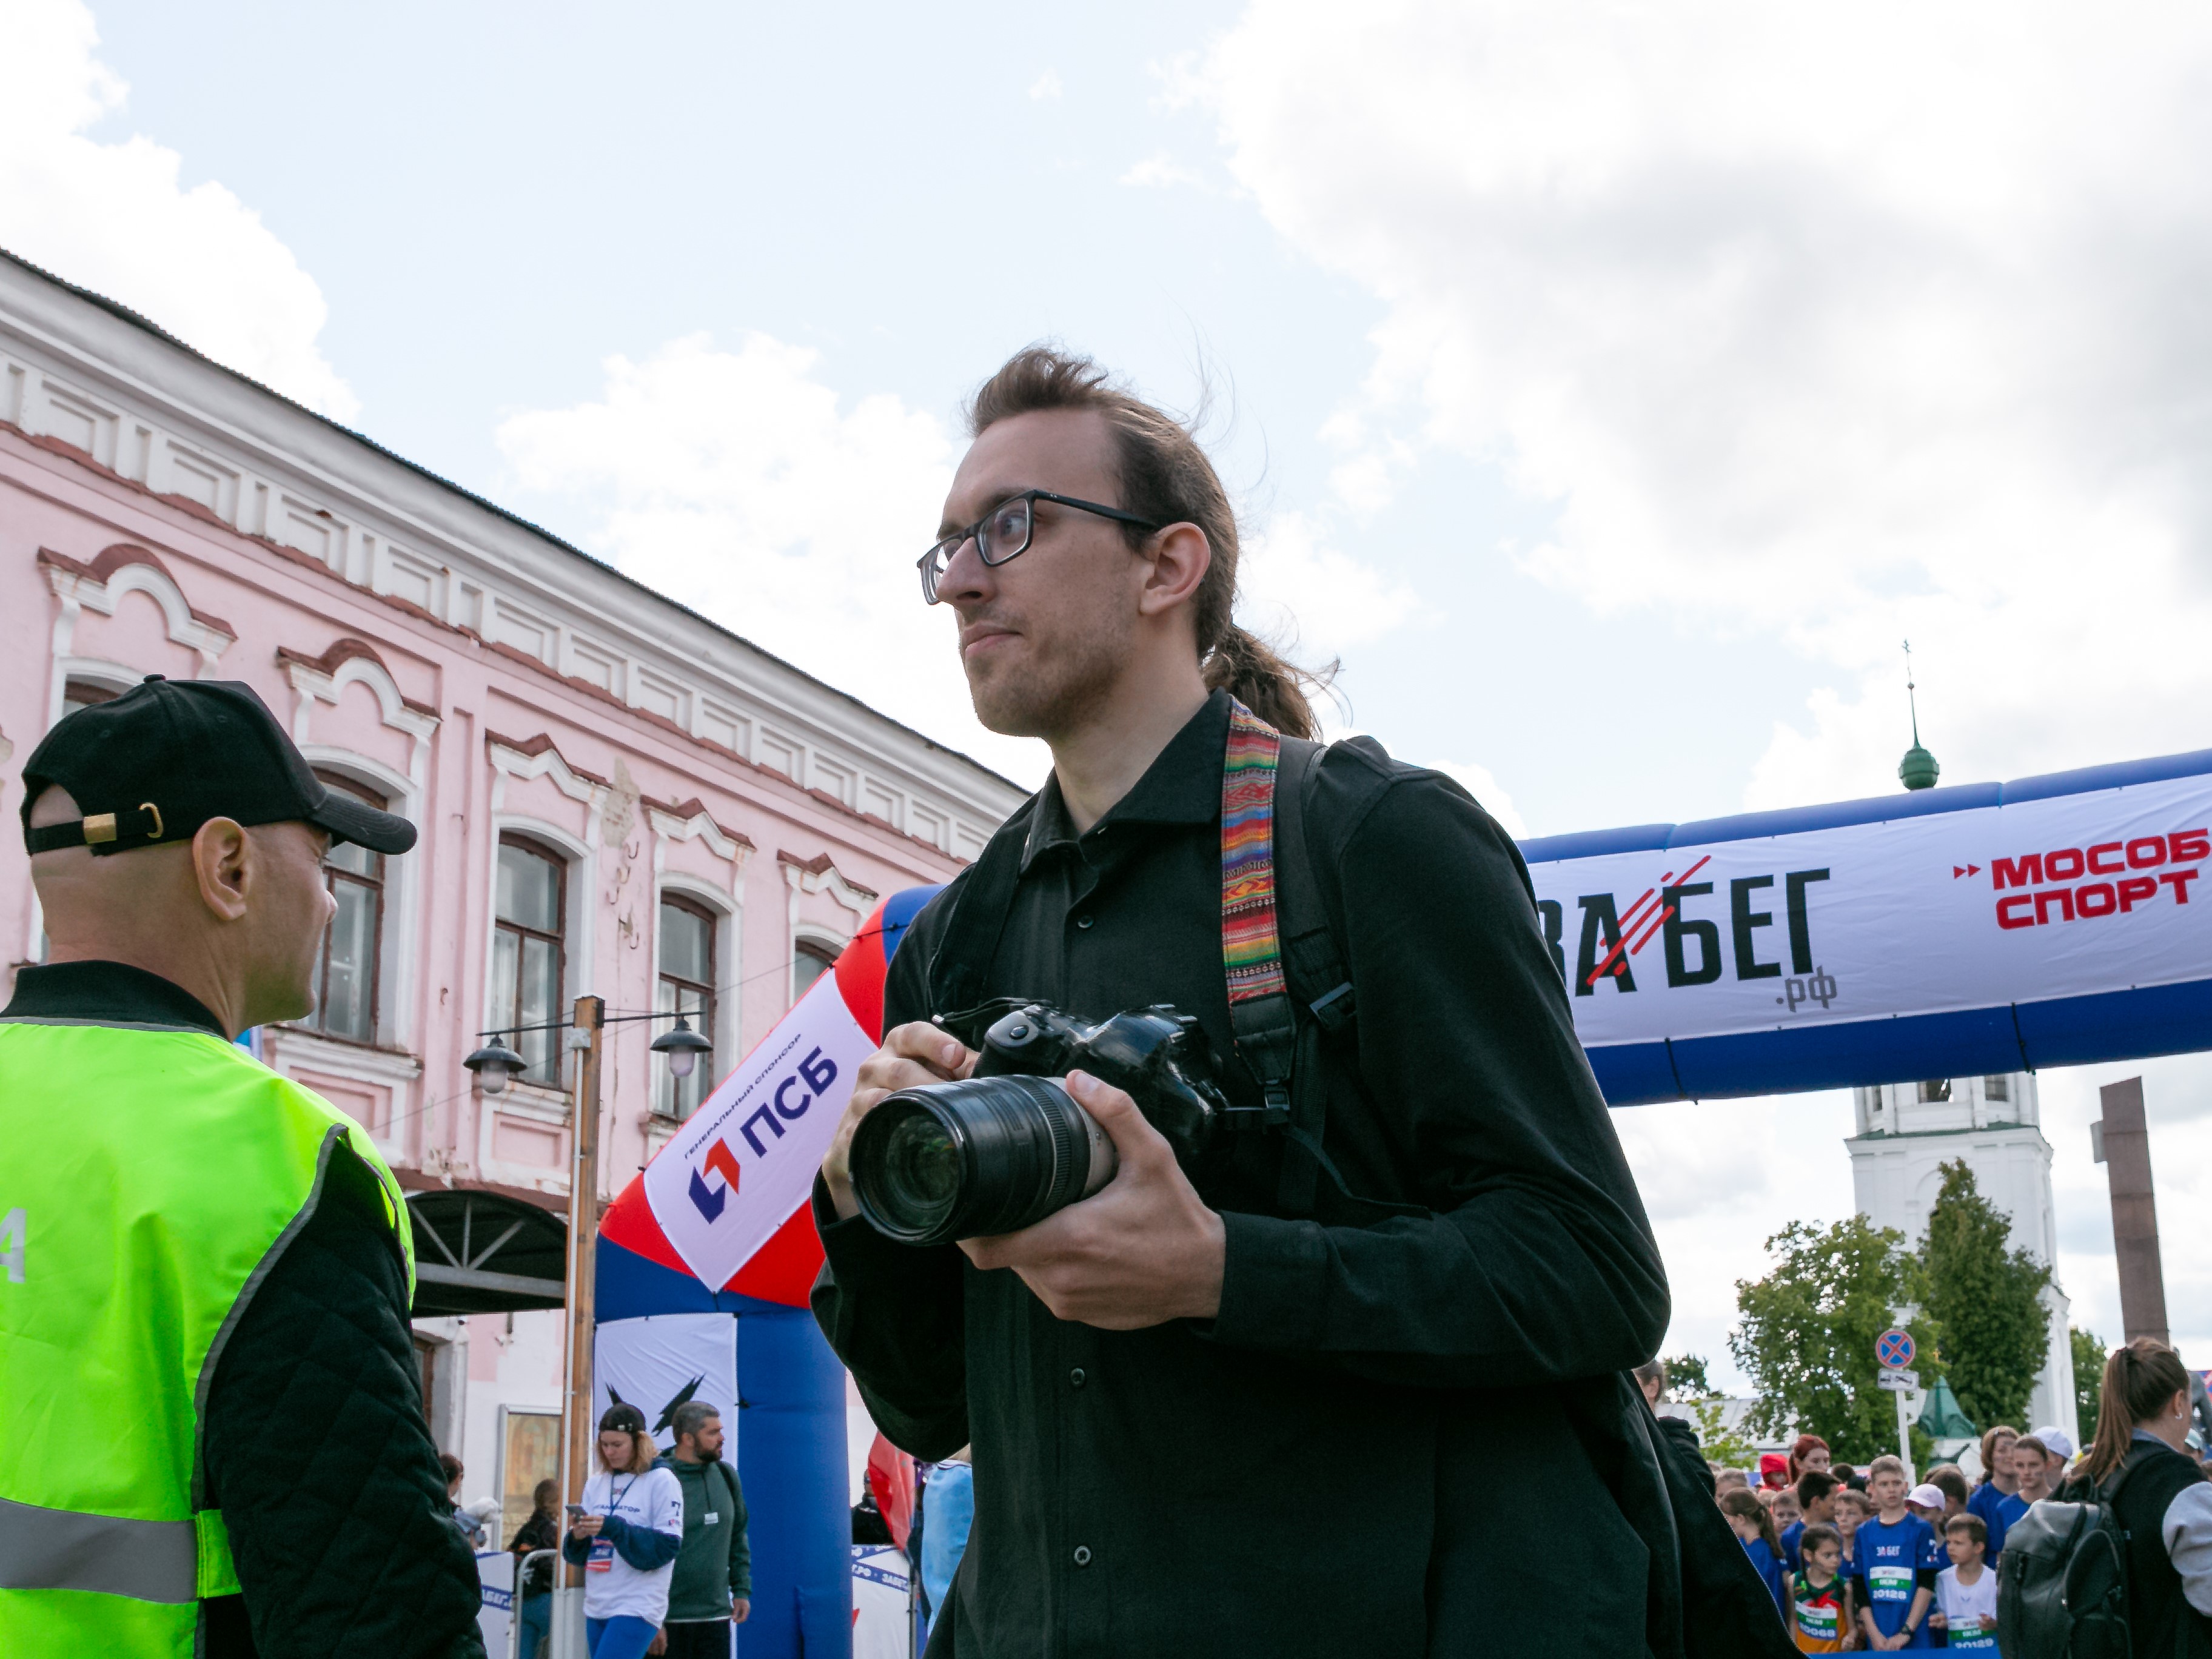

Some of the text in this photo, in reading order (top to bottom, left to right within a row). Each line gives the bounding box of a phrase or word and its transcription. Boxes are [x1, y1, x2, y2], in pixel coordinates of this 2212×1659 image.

[1991, 828, 2211, 890] МОСОБ
[1996, 868, 2199, 930] СПОРТ
[685, 1033, 801, 1160] ГЕНЕРАЛЬНЫЙ СПОНСОР
[740, 1045, 838, 1158] ПСБ
